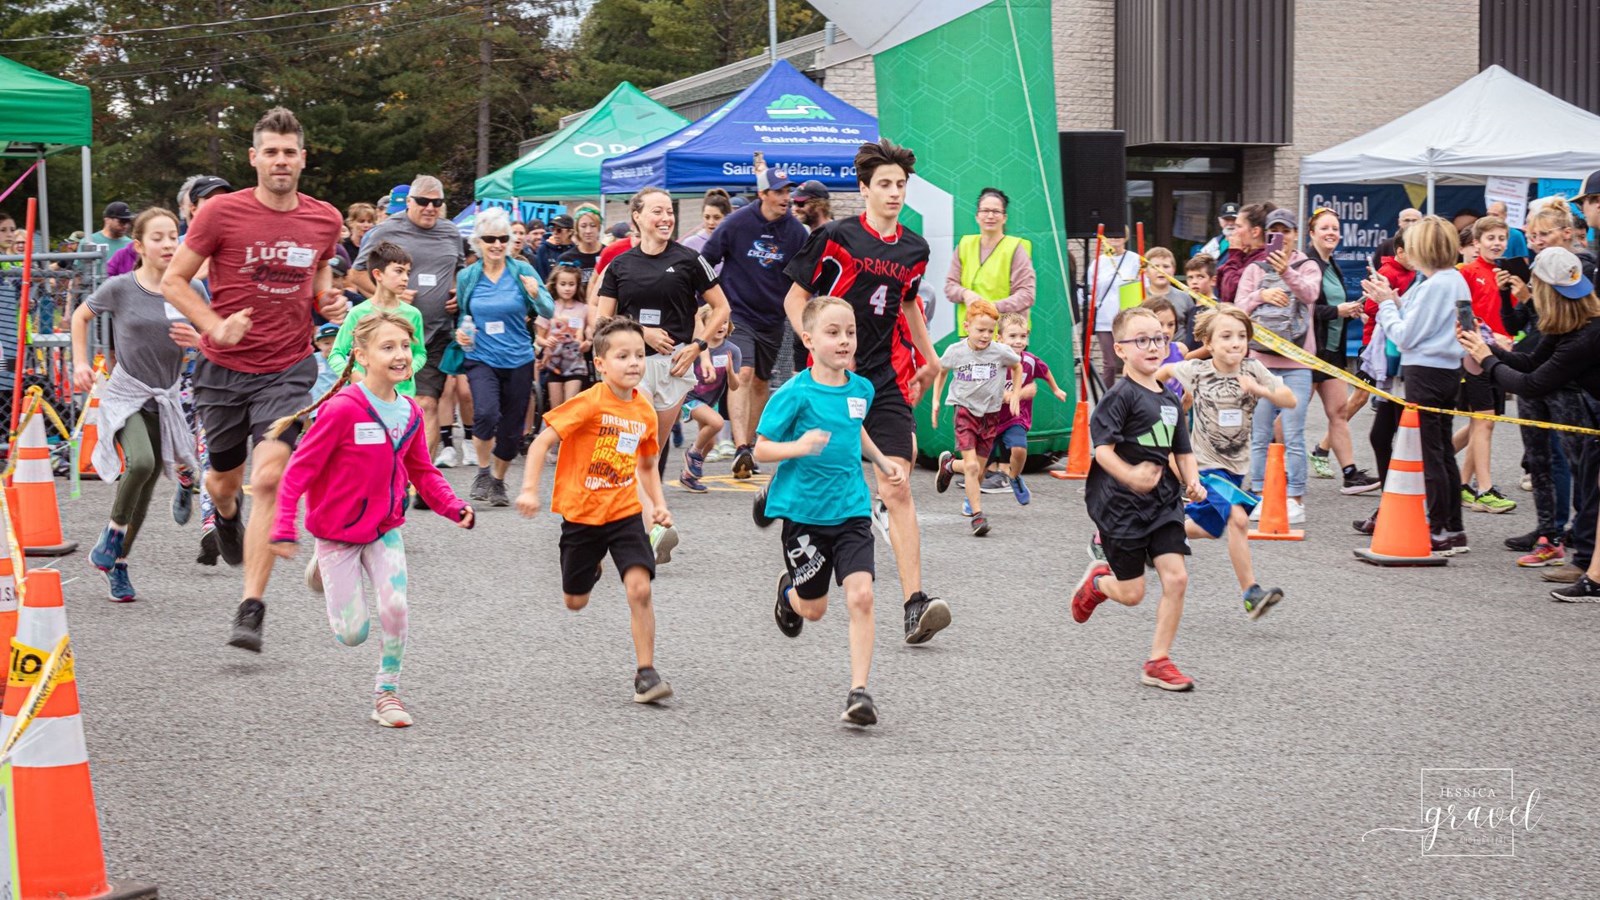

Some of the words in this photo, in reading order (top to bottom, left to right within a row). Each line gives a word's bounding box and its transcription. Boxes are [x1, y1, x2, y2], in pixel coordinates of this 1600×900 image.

[754, 124, 838, 135] Municipalité
[841, 127, 860, 135] de
[244, 247, 318, 265] LUC
[869, 284, 889, 316] 4
[601, 413, 629, 431] DREAM
